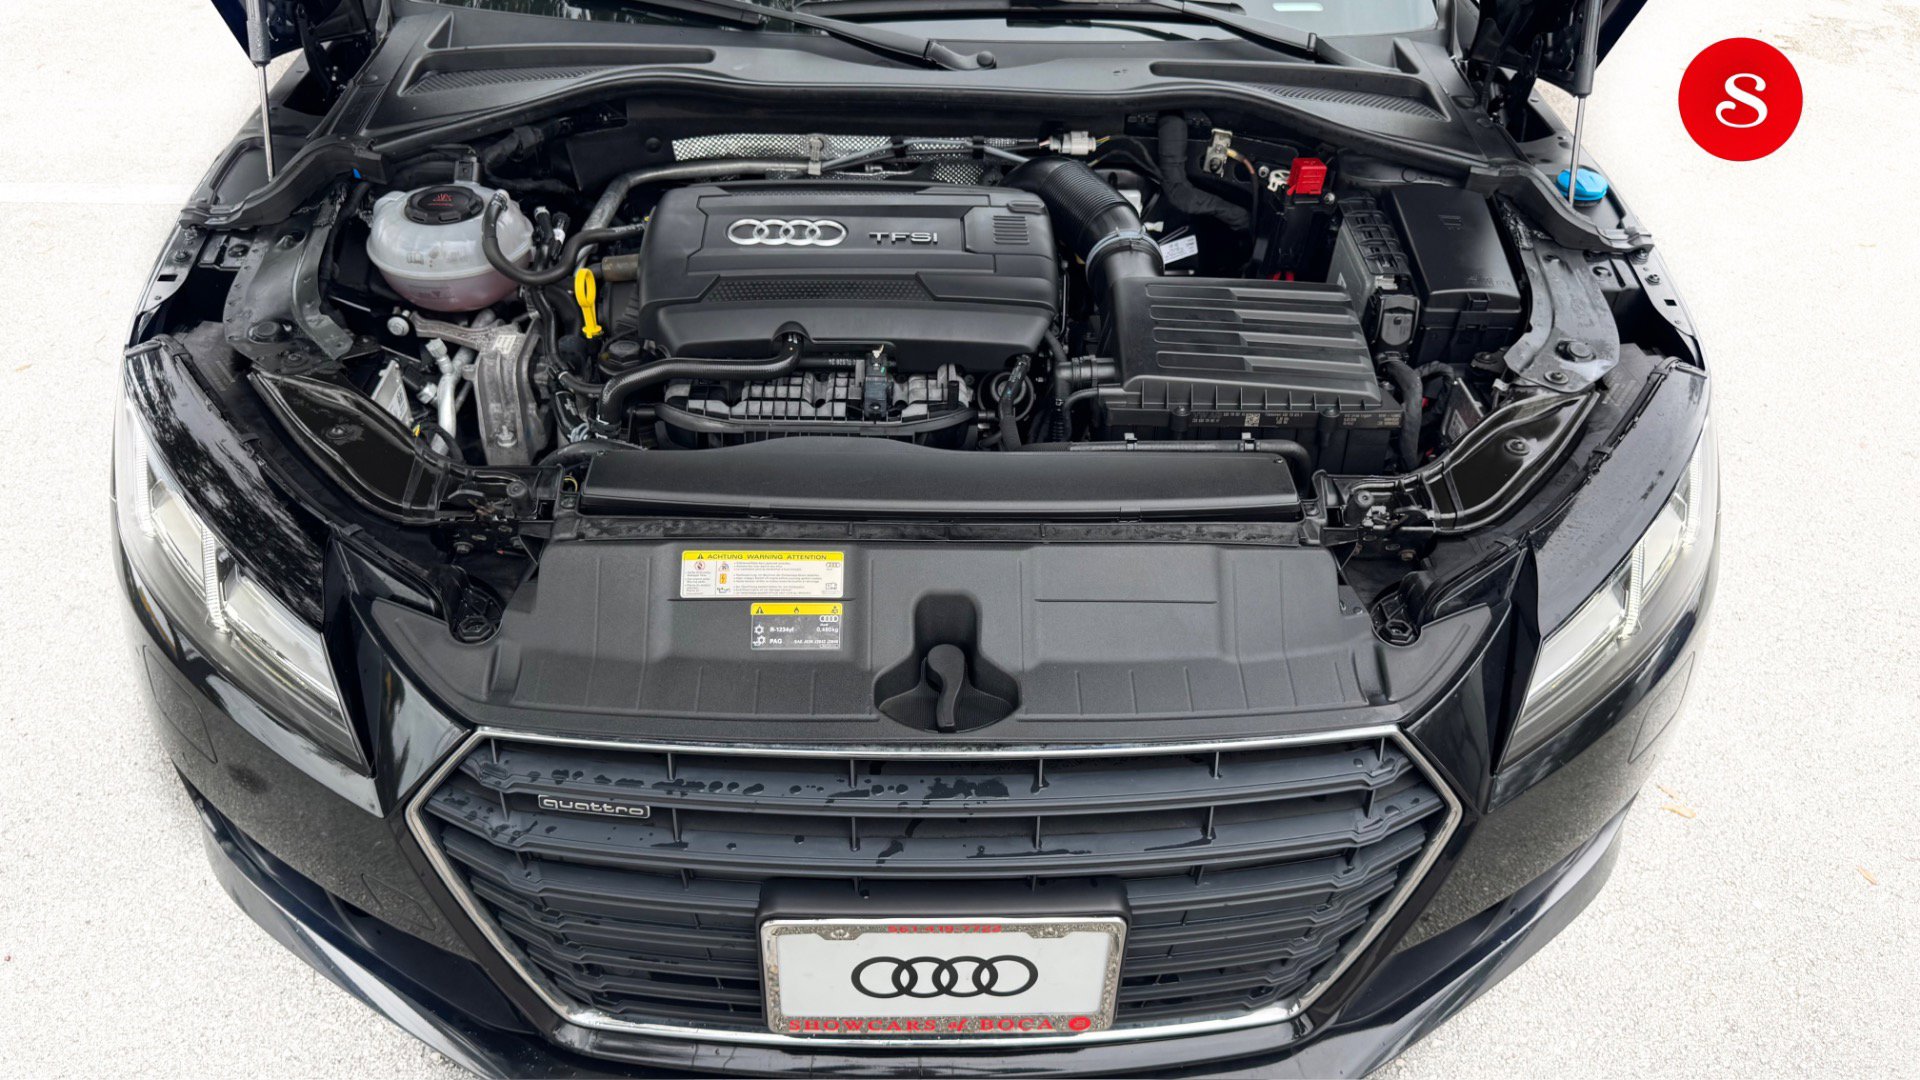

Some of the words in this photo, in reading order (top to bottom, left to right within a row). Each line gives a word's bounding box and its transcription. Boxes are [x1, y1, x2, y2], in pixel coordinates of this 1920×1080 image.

[868, 231, 938, 244] TFSI
[543, 799, 644, 815] quattro
[789, 1019, 936, 1032] SHOWCARS
[980, 1018, 1054, 1032] BOCA
